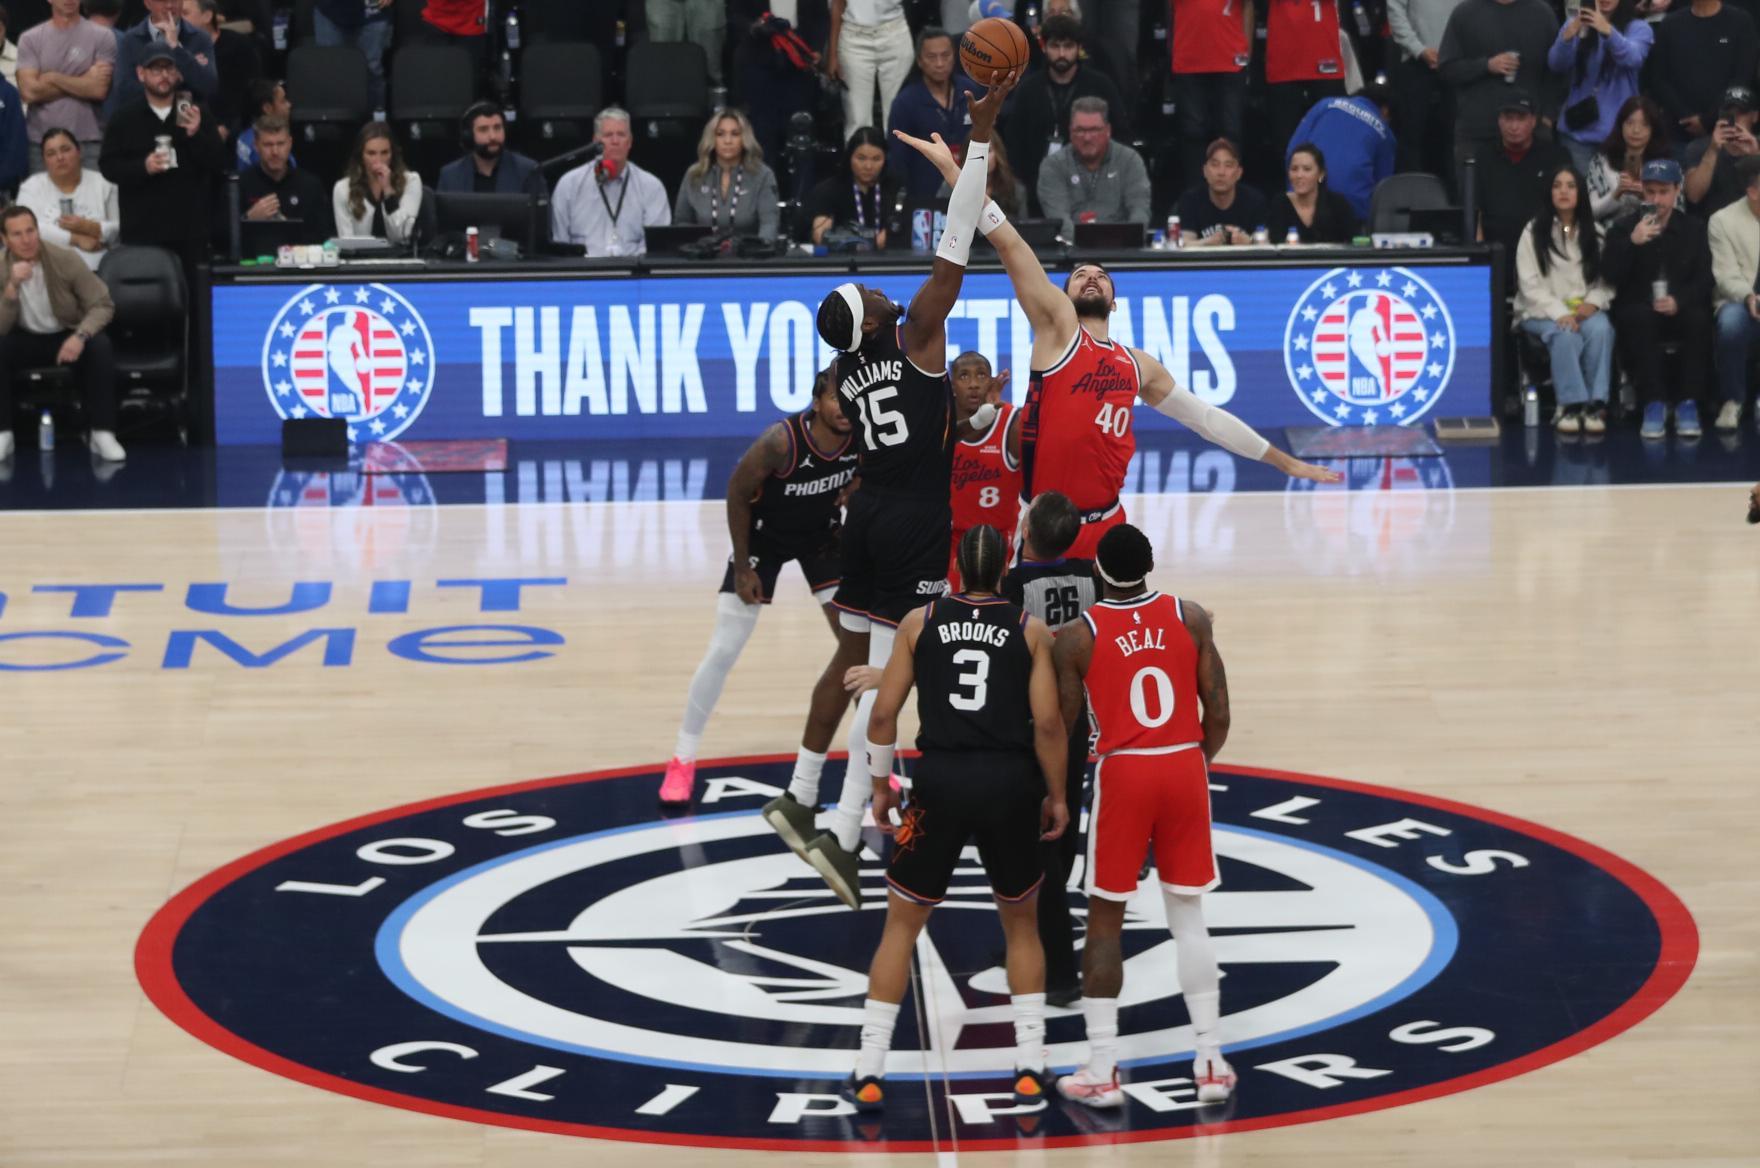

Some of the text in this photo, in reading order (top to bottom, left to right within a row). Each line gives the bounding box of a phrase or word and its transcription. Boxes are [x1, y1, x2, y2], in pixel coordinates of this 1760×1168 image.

[469, 306, 708, 417] THANK
[840, 360, 903, 402] WILLIAMS
[1095, 357, 1121, 377] Los
[1071, 372, 1133, 402] Angeles
[1352, 377, 1377, 396] NBA
[855, 385, 909, 451] 15
[1094, 402, 1130, 438] 40
[784, 466, 857, 497] PHOENIX
[978, 486, 1000, 508] 8
[1045, 584, 1080, 627] 26
[937, 621, 1011, 648] BROOKS
[1115, 627, 1167, 658] BEAL
[949, 648, 990, 712] 3
[1129, 665, 1176, 729] 0
[275, 808, 557, 897] LOS
[369, 1020, 1497, 1125] CLIPPERS
